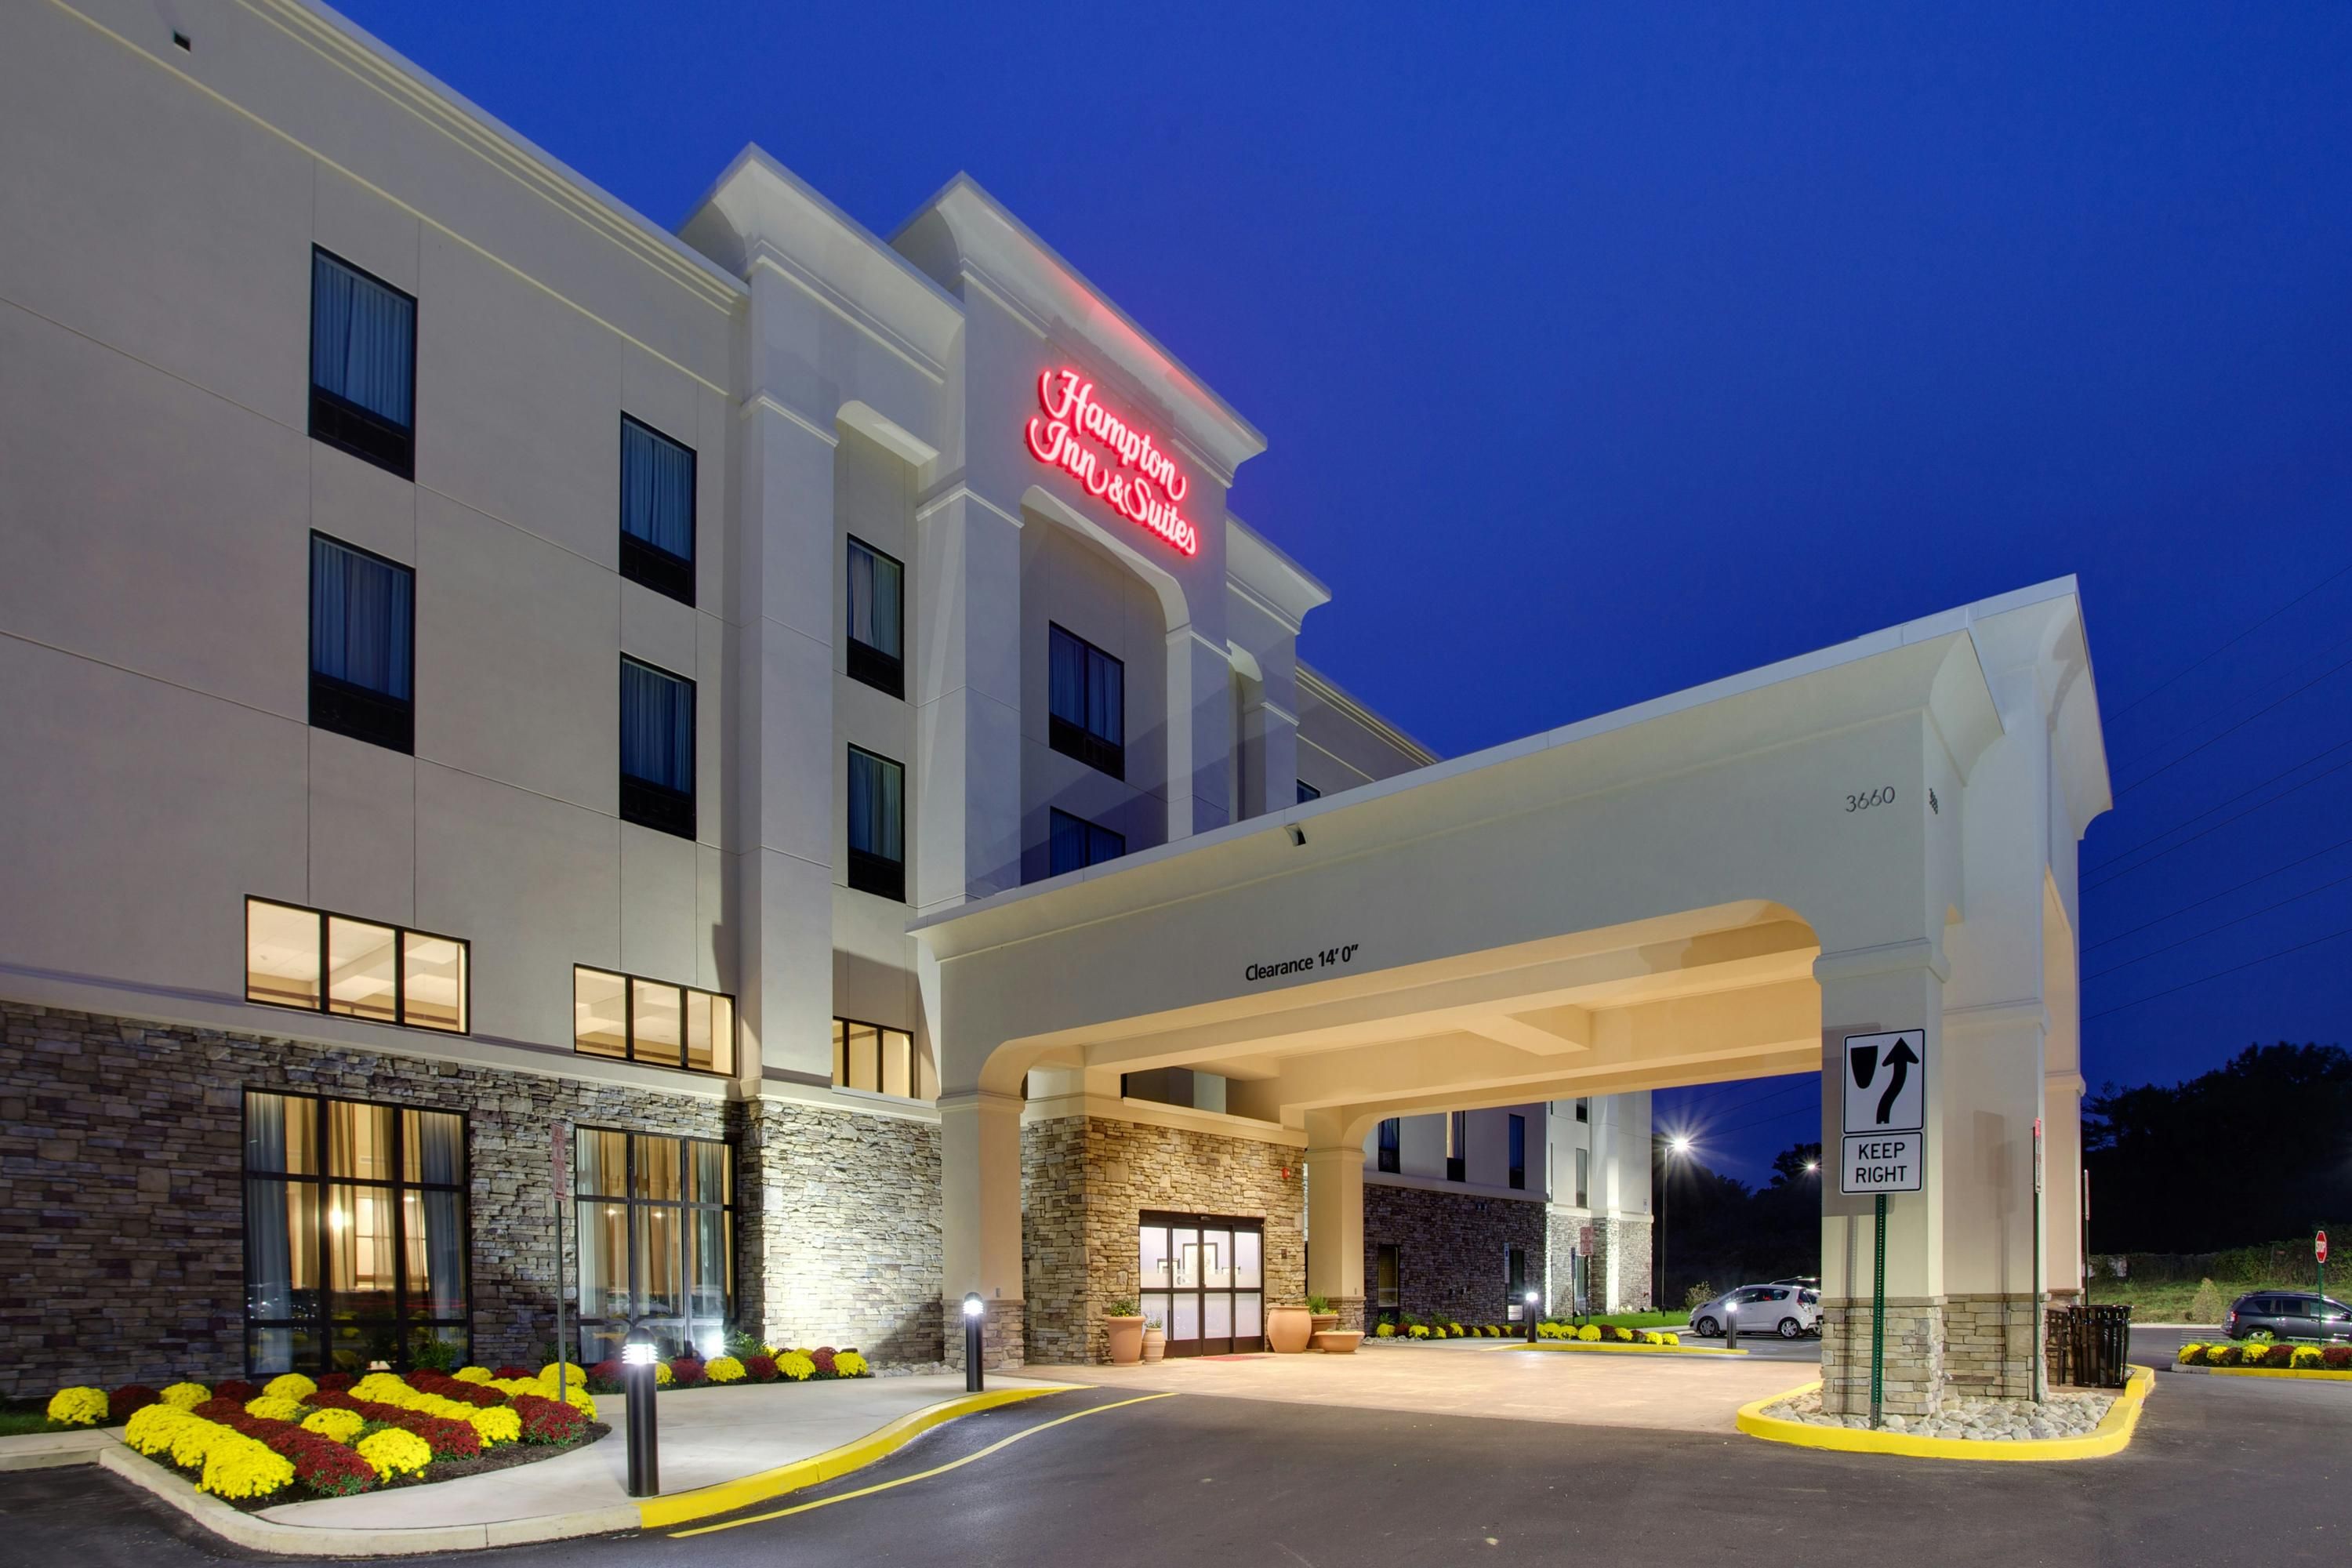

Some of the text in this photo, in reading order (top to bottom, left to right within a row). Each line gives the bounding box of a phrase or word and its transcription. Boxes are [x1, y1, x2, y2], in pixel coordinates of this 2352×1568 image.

[1039, 369, 1187, 502] Hampton
[1026, 418, 1197, 555] Inn & Suites
[1846, 786, 1895, 812] 3660
[1245, 957, 1314, 981] Clearance
[1858, 1142, 1905, 1160] KEEP
[1855, 1166, 1907, 1184] RIGHT
